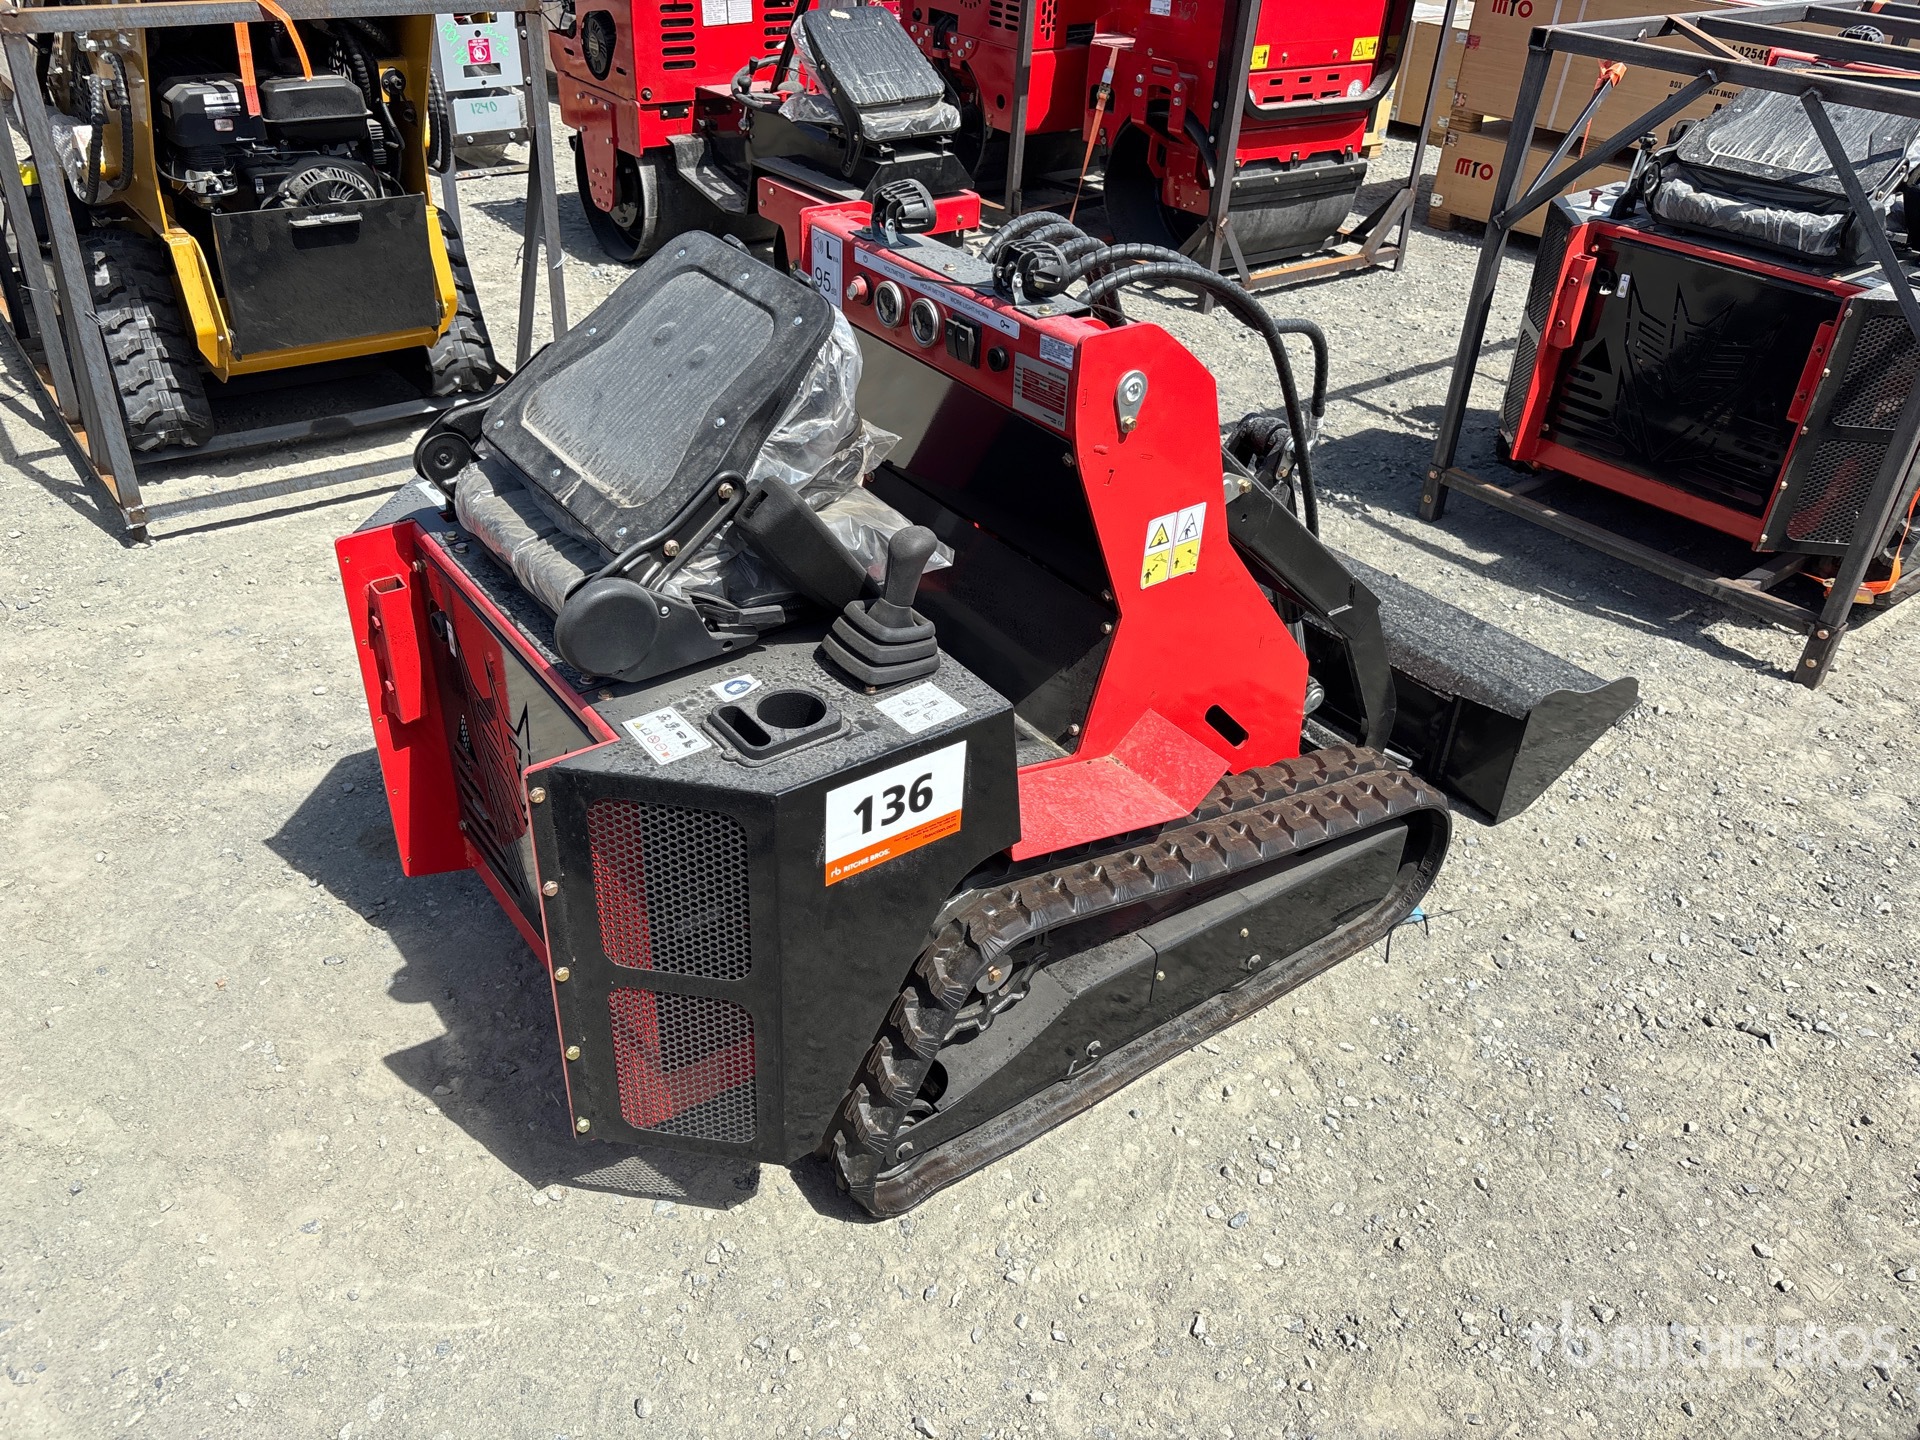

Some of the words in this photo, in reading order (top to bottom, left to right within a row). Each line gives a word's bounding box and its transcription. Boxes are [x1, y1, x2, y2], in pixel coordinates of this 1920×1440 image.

[470, 101, 498, 114] 1240
[1455, 157, 1494, 181] MTO
[815, 266, 831, 293] 95
[853, 772, 934, 835] 136
[830, 865, 842, 878] rb
